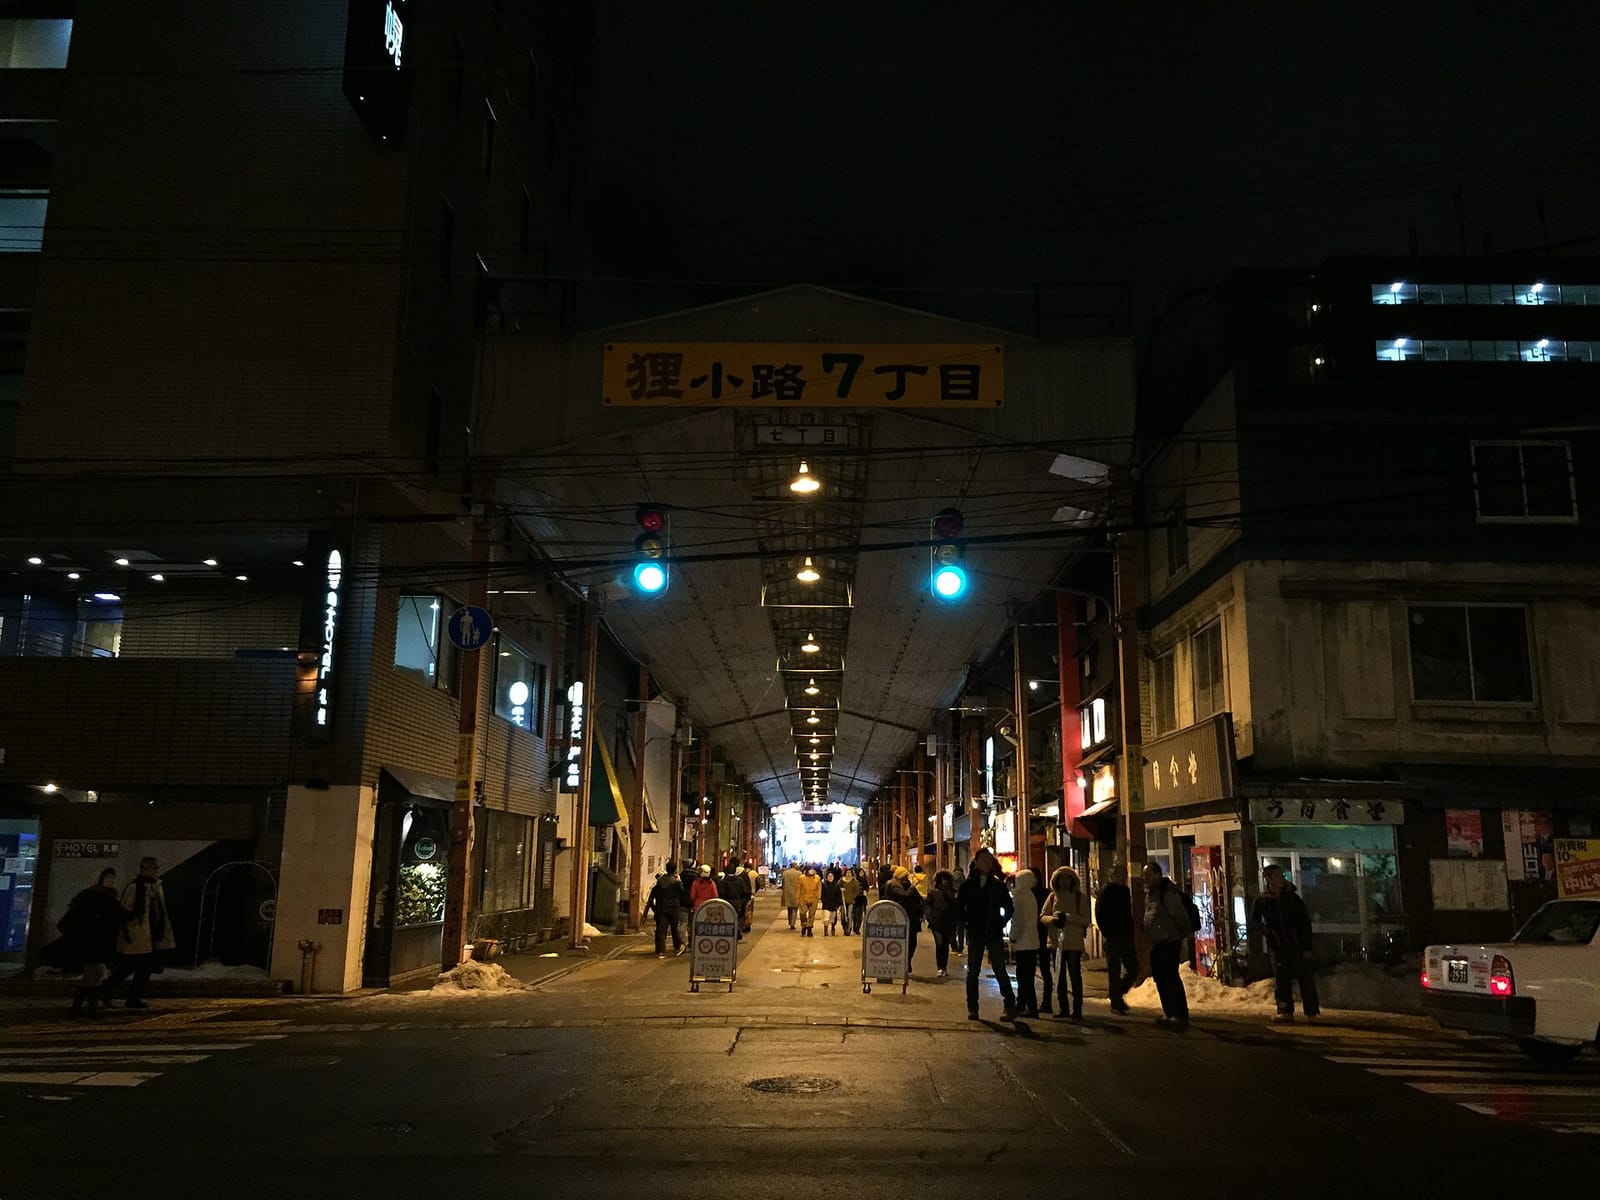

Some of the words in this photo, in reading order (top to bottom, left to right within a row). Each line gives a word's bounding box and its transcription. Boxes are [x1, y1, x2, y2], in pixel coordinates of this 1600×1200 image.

[625, 352, 982, 401] 狸小路7丁目
[769, 428, 836, 443] 七丁目
